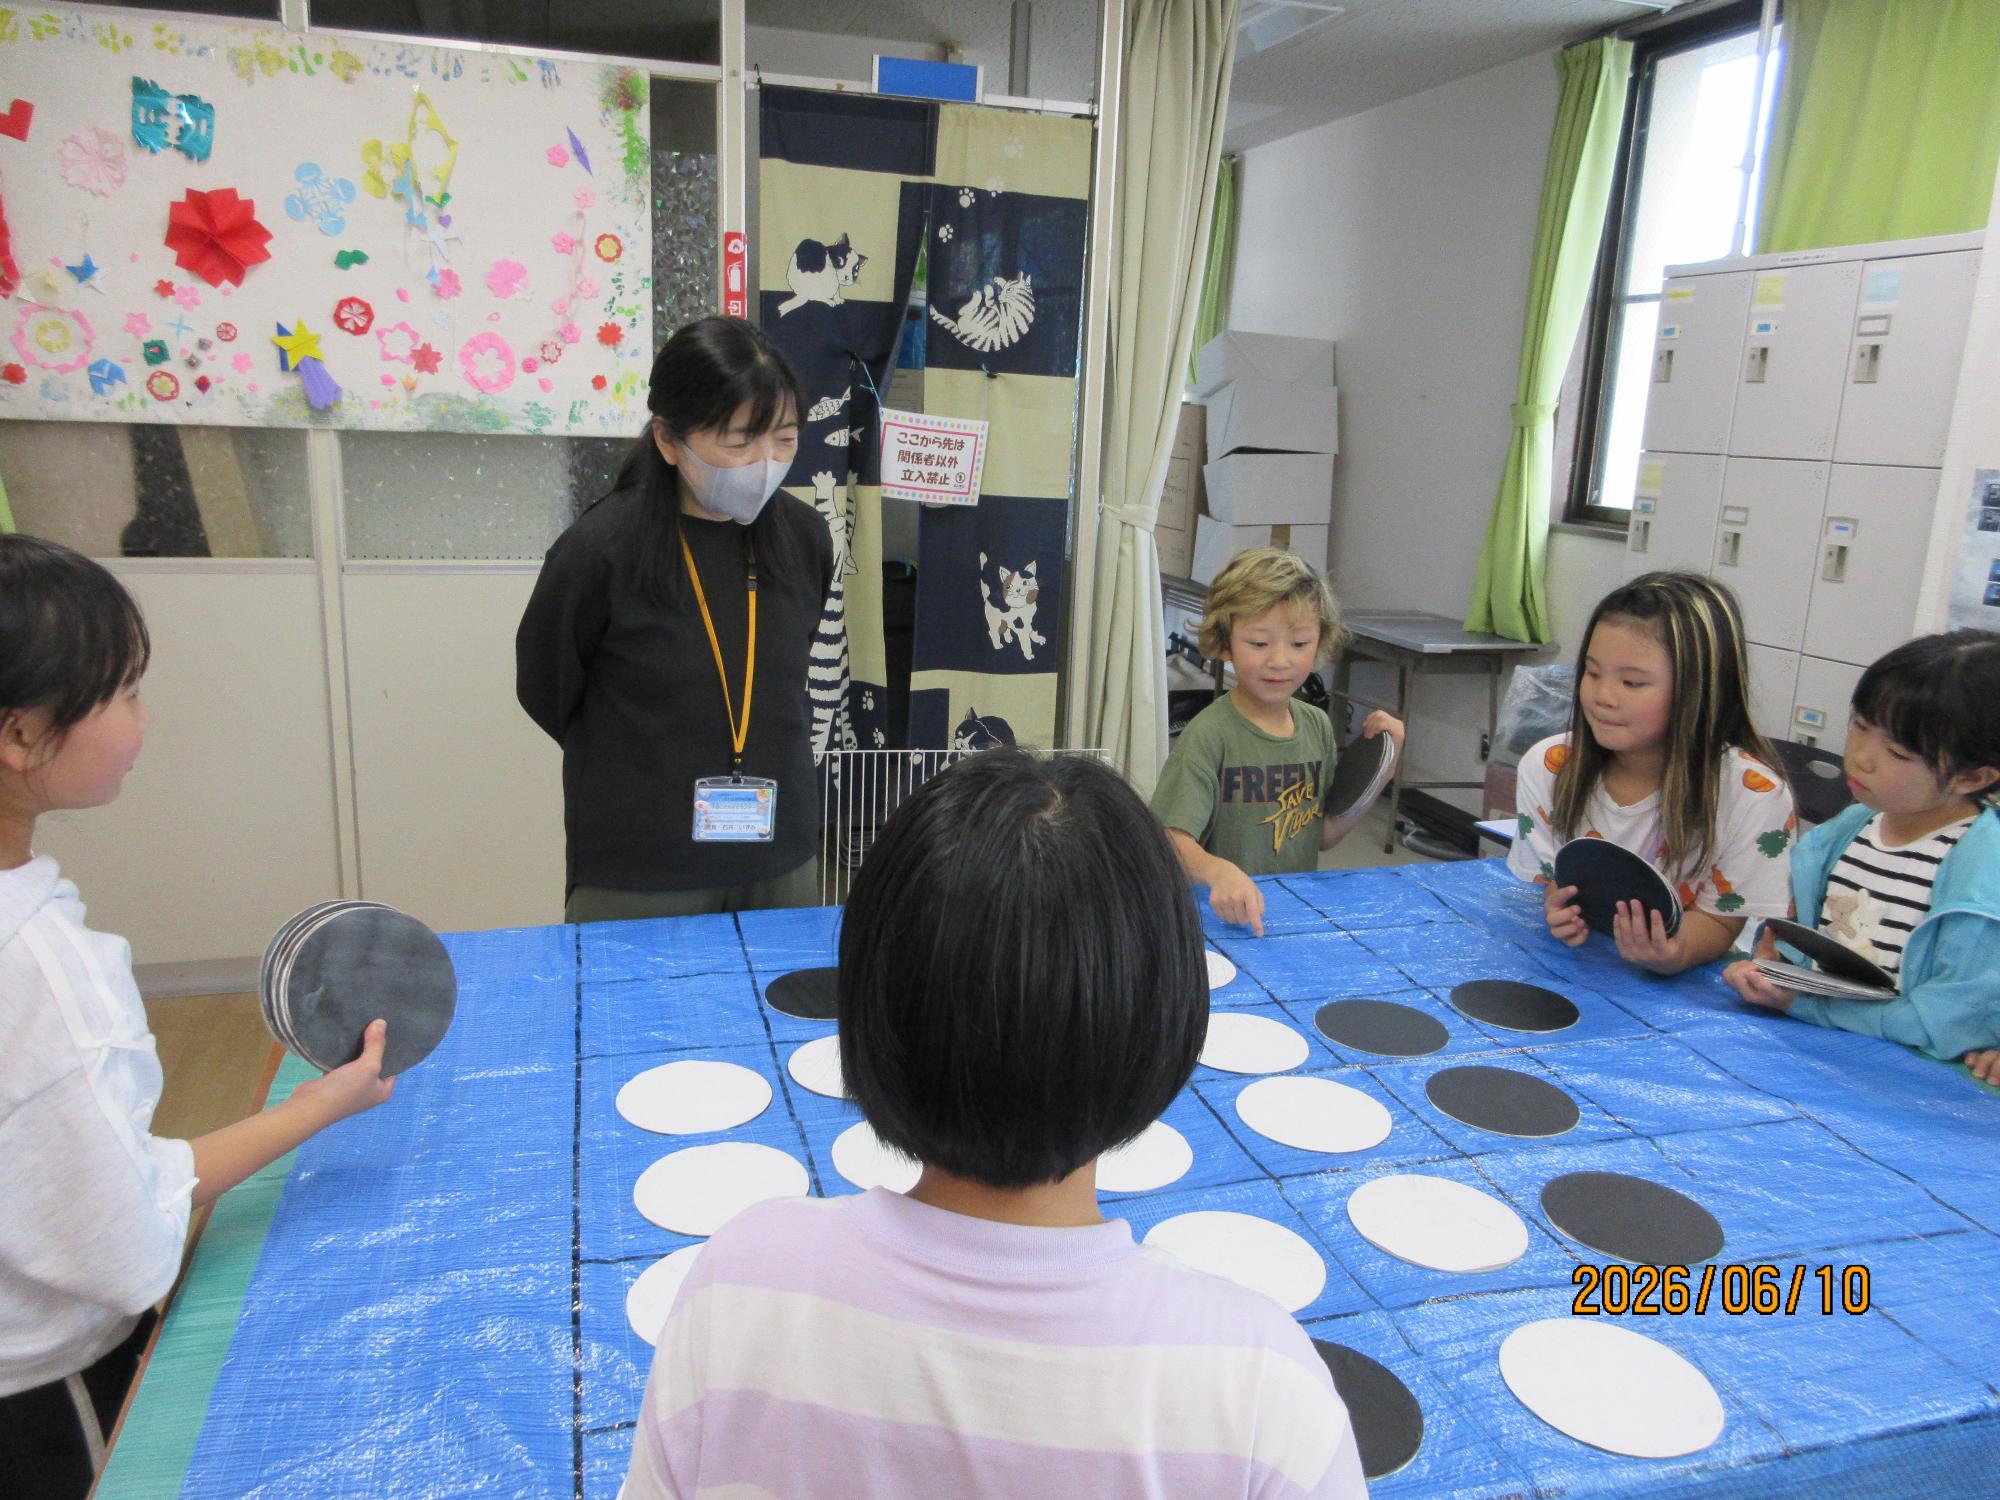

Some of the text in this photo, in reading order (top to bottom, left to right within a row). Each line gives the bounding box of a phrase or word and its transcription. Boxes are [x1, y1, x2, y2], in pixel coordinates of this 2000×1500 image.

[896, 431, 965, 452] ここから先は
[897, 449, 959, 469] 関係者以外
[900, 468, 950, 486] 立入禁止
